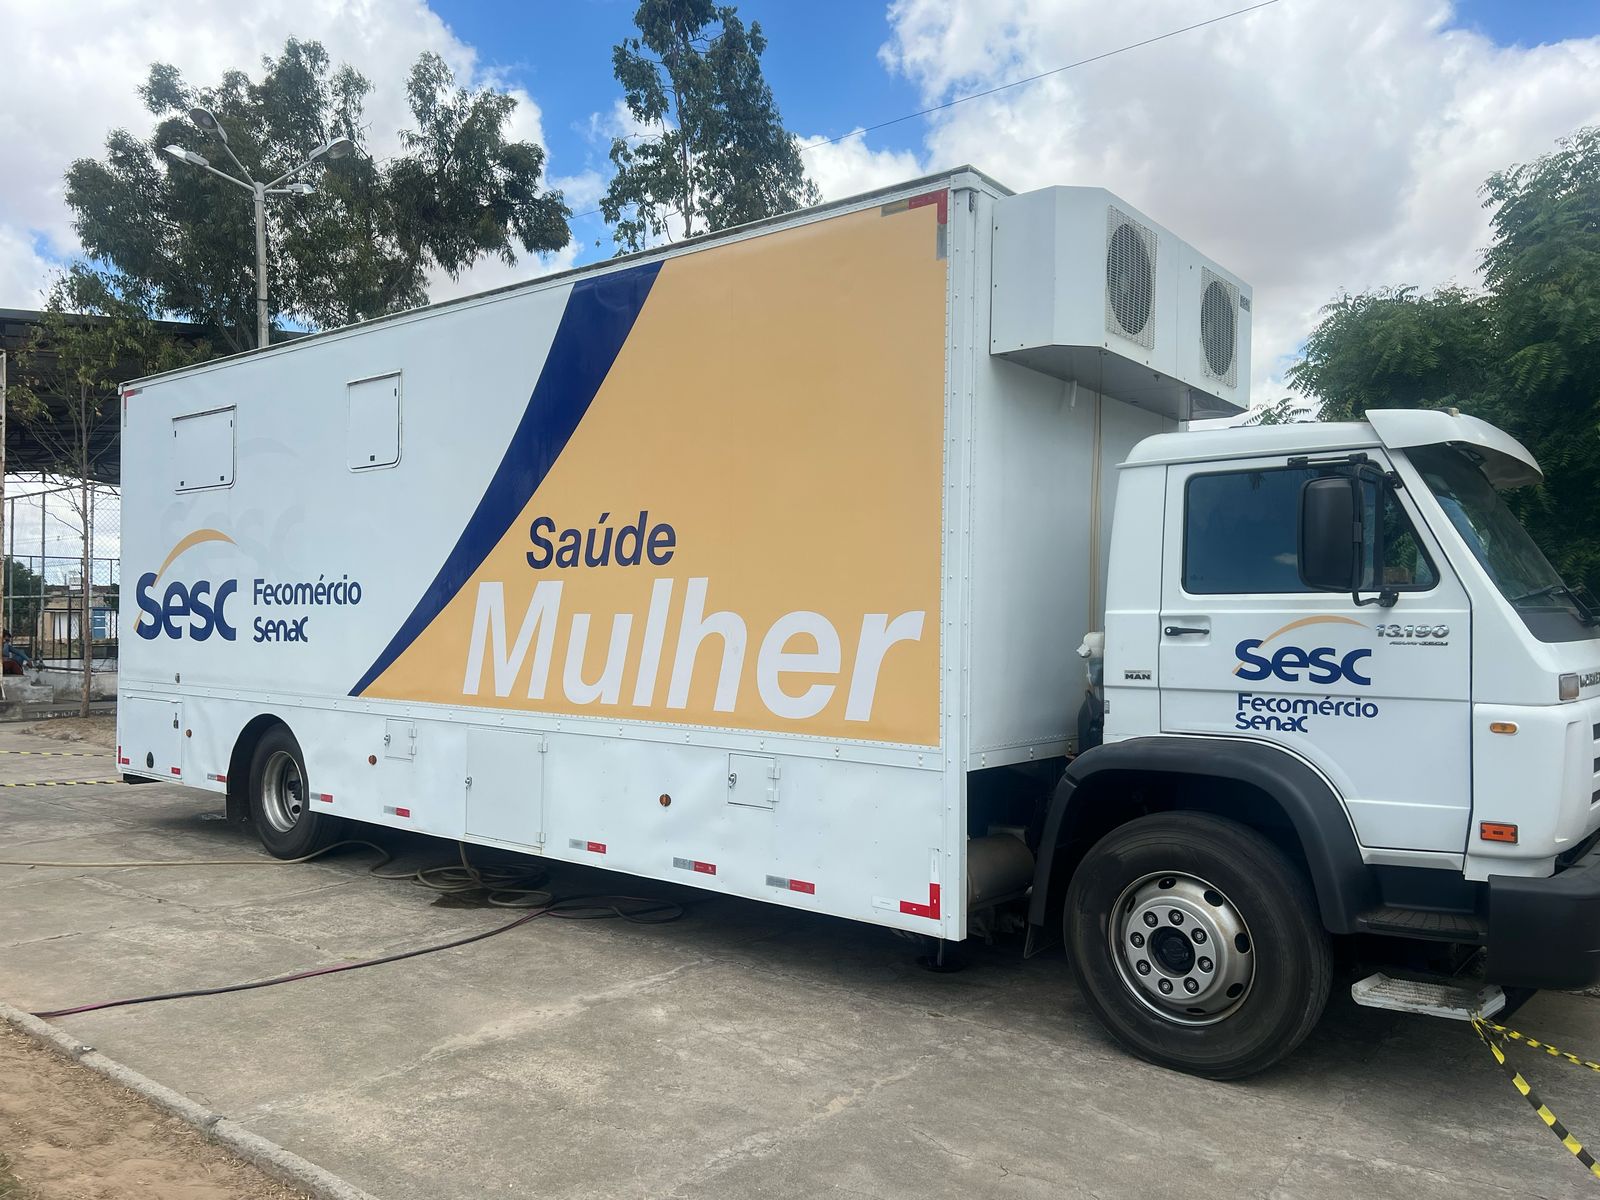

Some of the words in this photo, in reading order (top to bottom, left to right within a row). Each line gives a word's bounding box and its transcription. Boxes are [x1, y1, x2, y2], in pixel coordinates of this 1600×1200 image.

[526, 510, 676, 569] Saúde
[253, 574, 362, 605] Fecomércio
[136, 572, 237, 641] Sesc
[253, 616, 309, 643] Senac
[1375, 624, 1449, 638] 13.190
[462, 577, 925, 722] Mulher
[1235, 639, 1372, 685] Sesc
[1238, 693, 1379, 718] Fecomércio
[1235, 712, 1309, 733] Senac
